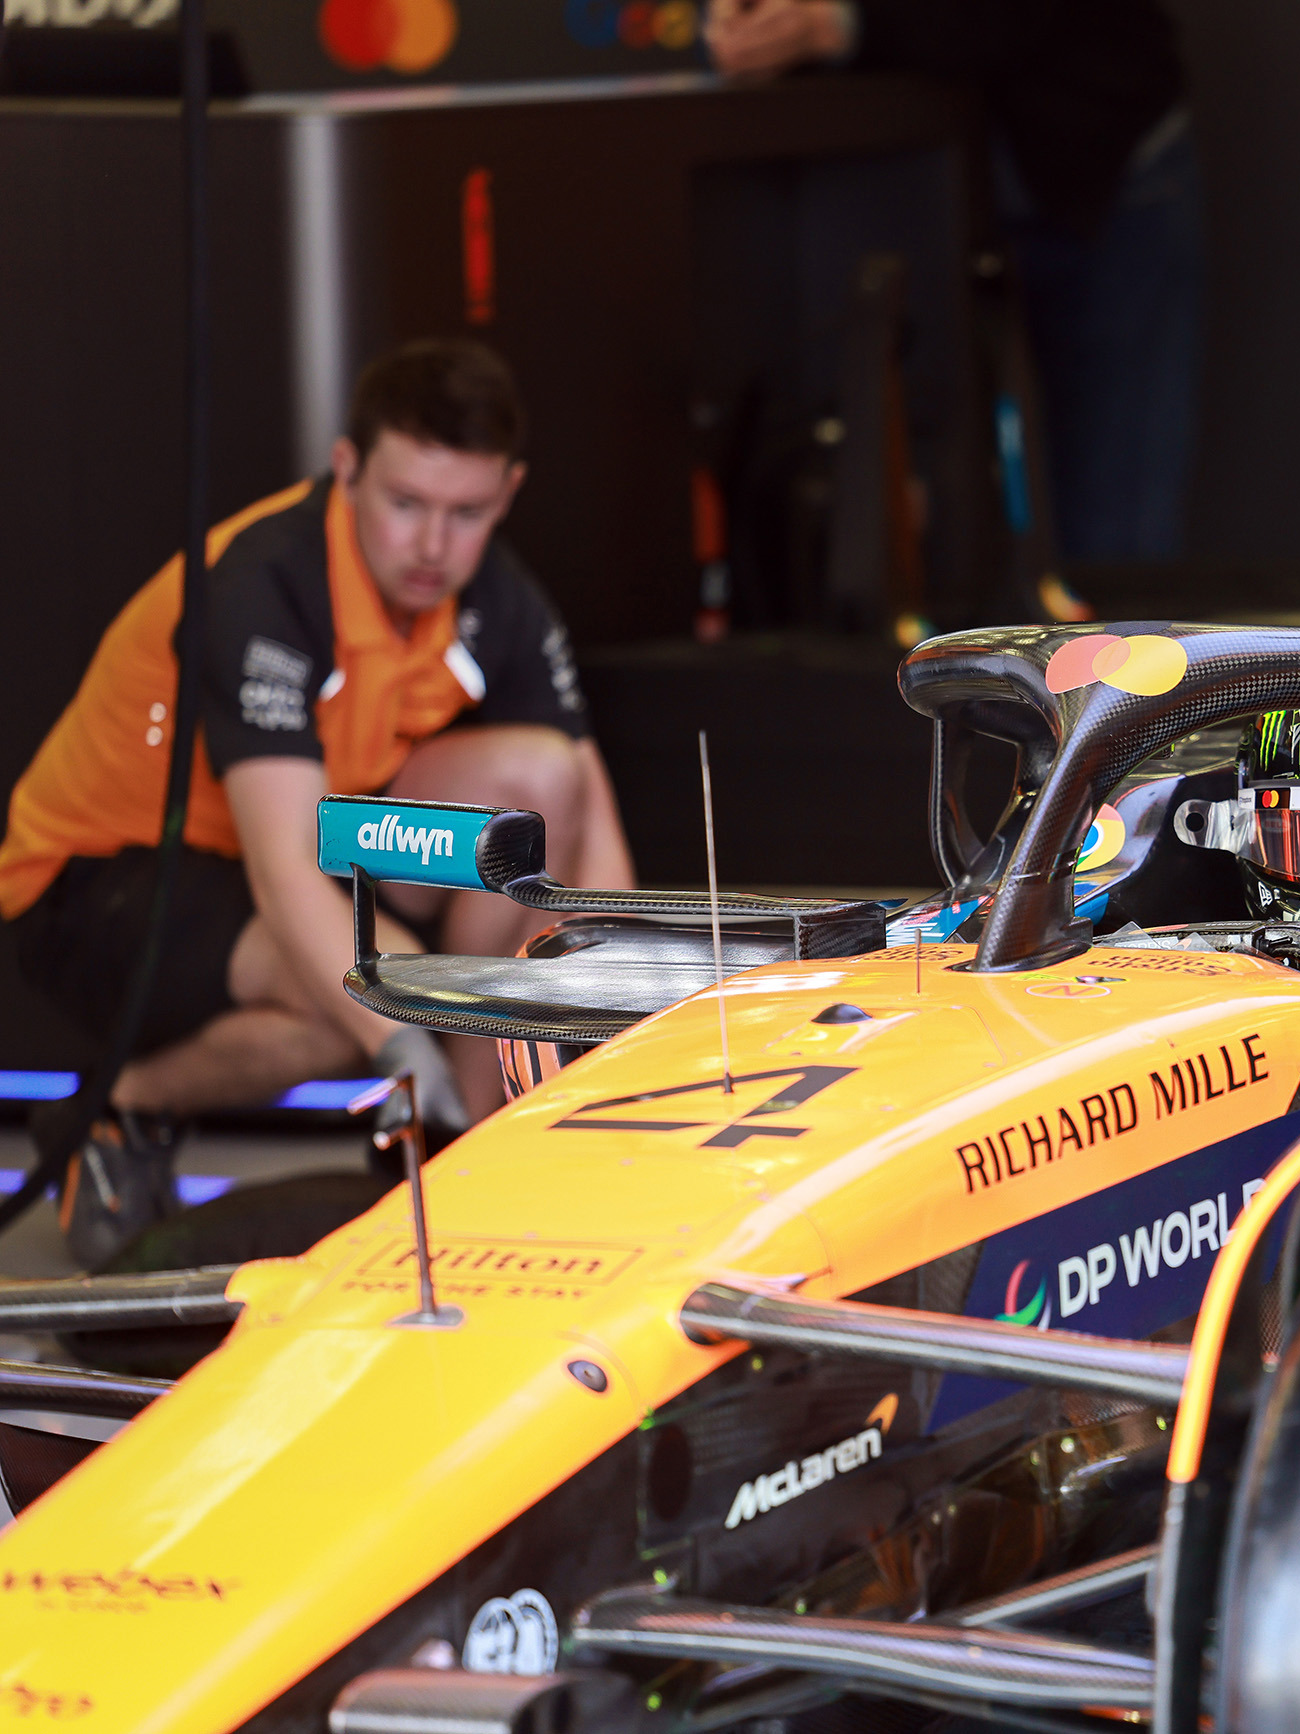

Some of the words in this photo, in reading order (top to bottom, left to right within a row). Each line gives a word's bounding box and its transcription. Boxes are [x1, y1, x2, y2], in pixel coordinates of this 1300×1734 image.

[357, 814, 454, 865] allwyn
[550, 1065, 861, 1149] 4
[956, 1082, 1138, 1193] RICHARD
[1148, 1033, 1269, 1121] MILLE
[1058, 1242, 1117, 1318] DP
[725, 1427, 883, 1530] McLaren
